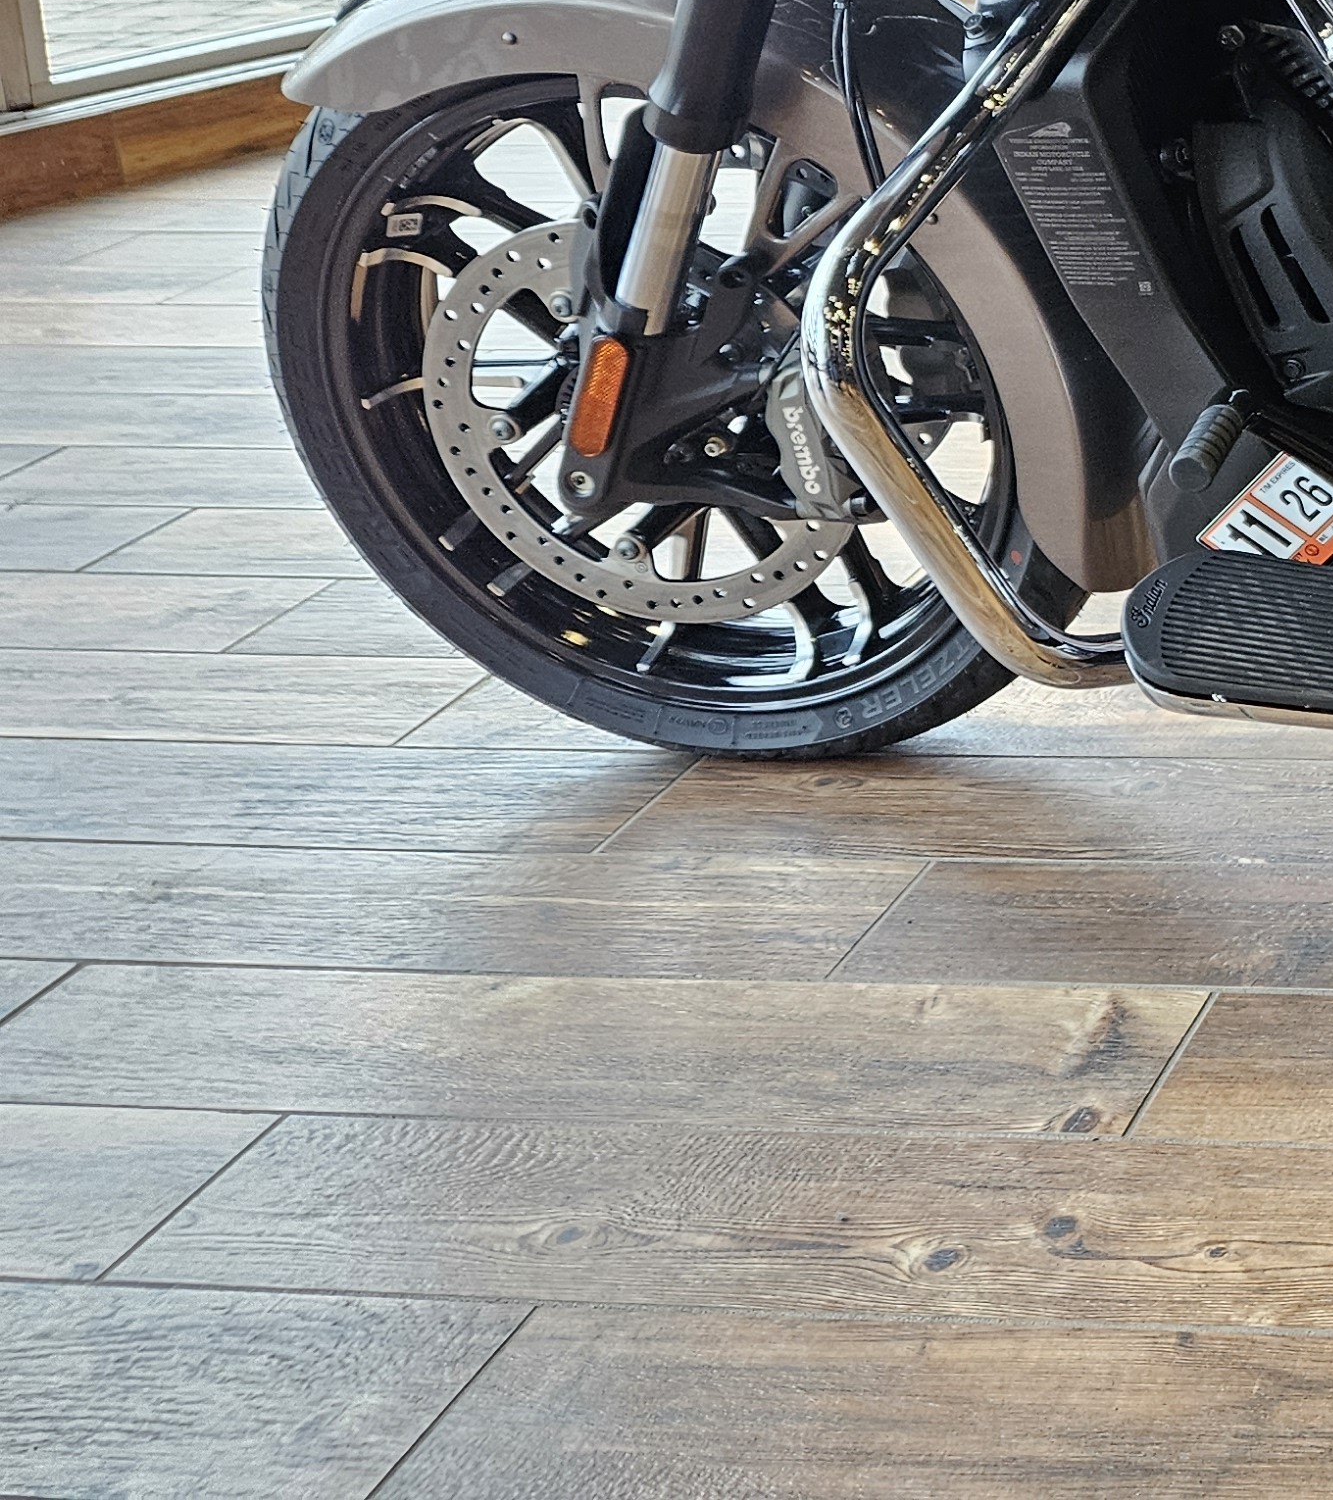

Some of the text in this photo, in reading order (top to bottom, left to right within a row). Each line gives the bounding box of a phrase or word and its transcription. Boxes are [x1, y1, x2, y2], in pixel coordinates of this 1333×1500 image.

[782, 406, 821, 495] brembo
[1271, 461, 1296, 485] EXPIRES
[1279, 476, 1333, 523] 26
[1226, 509, 1292, 560] 11
[1131, 579, 1168, 628] Indian
[862, 636, 978, 721] TZELER
